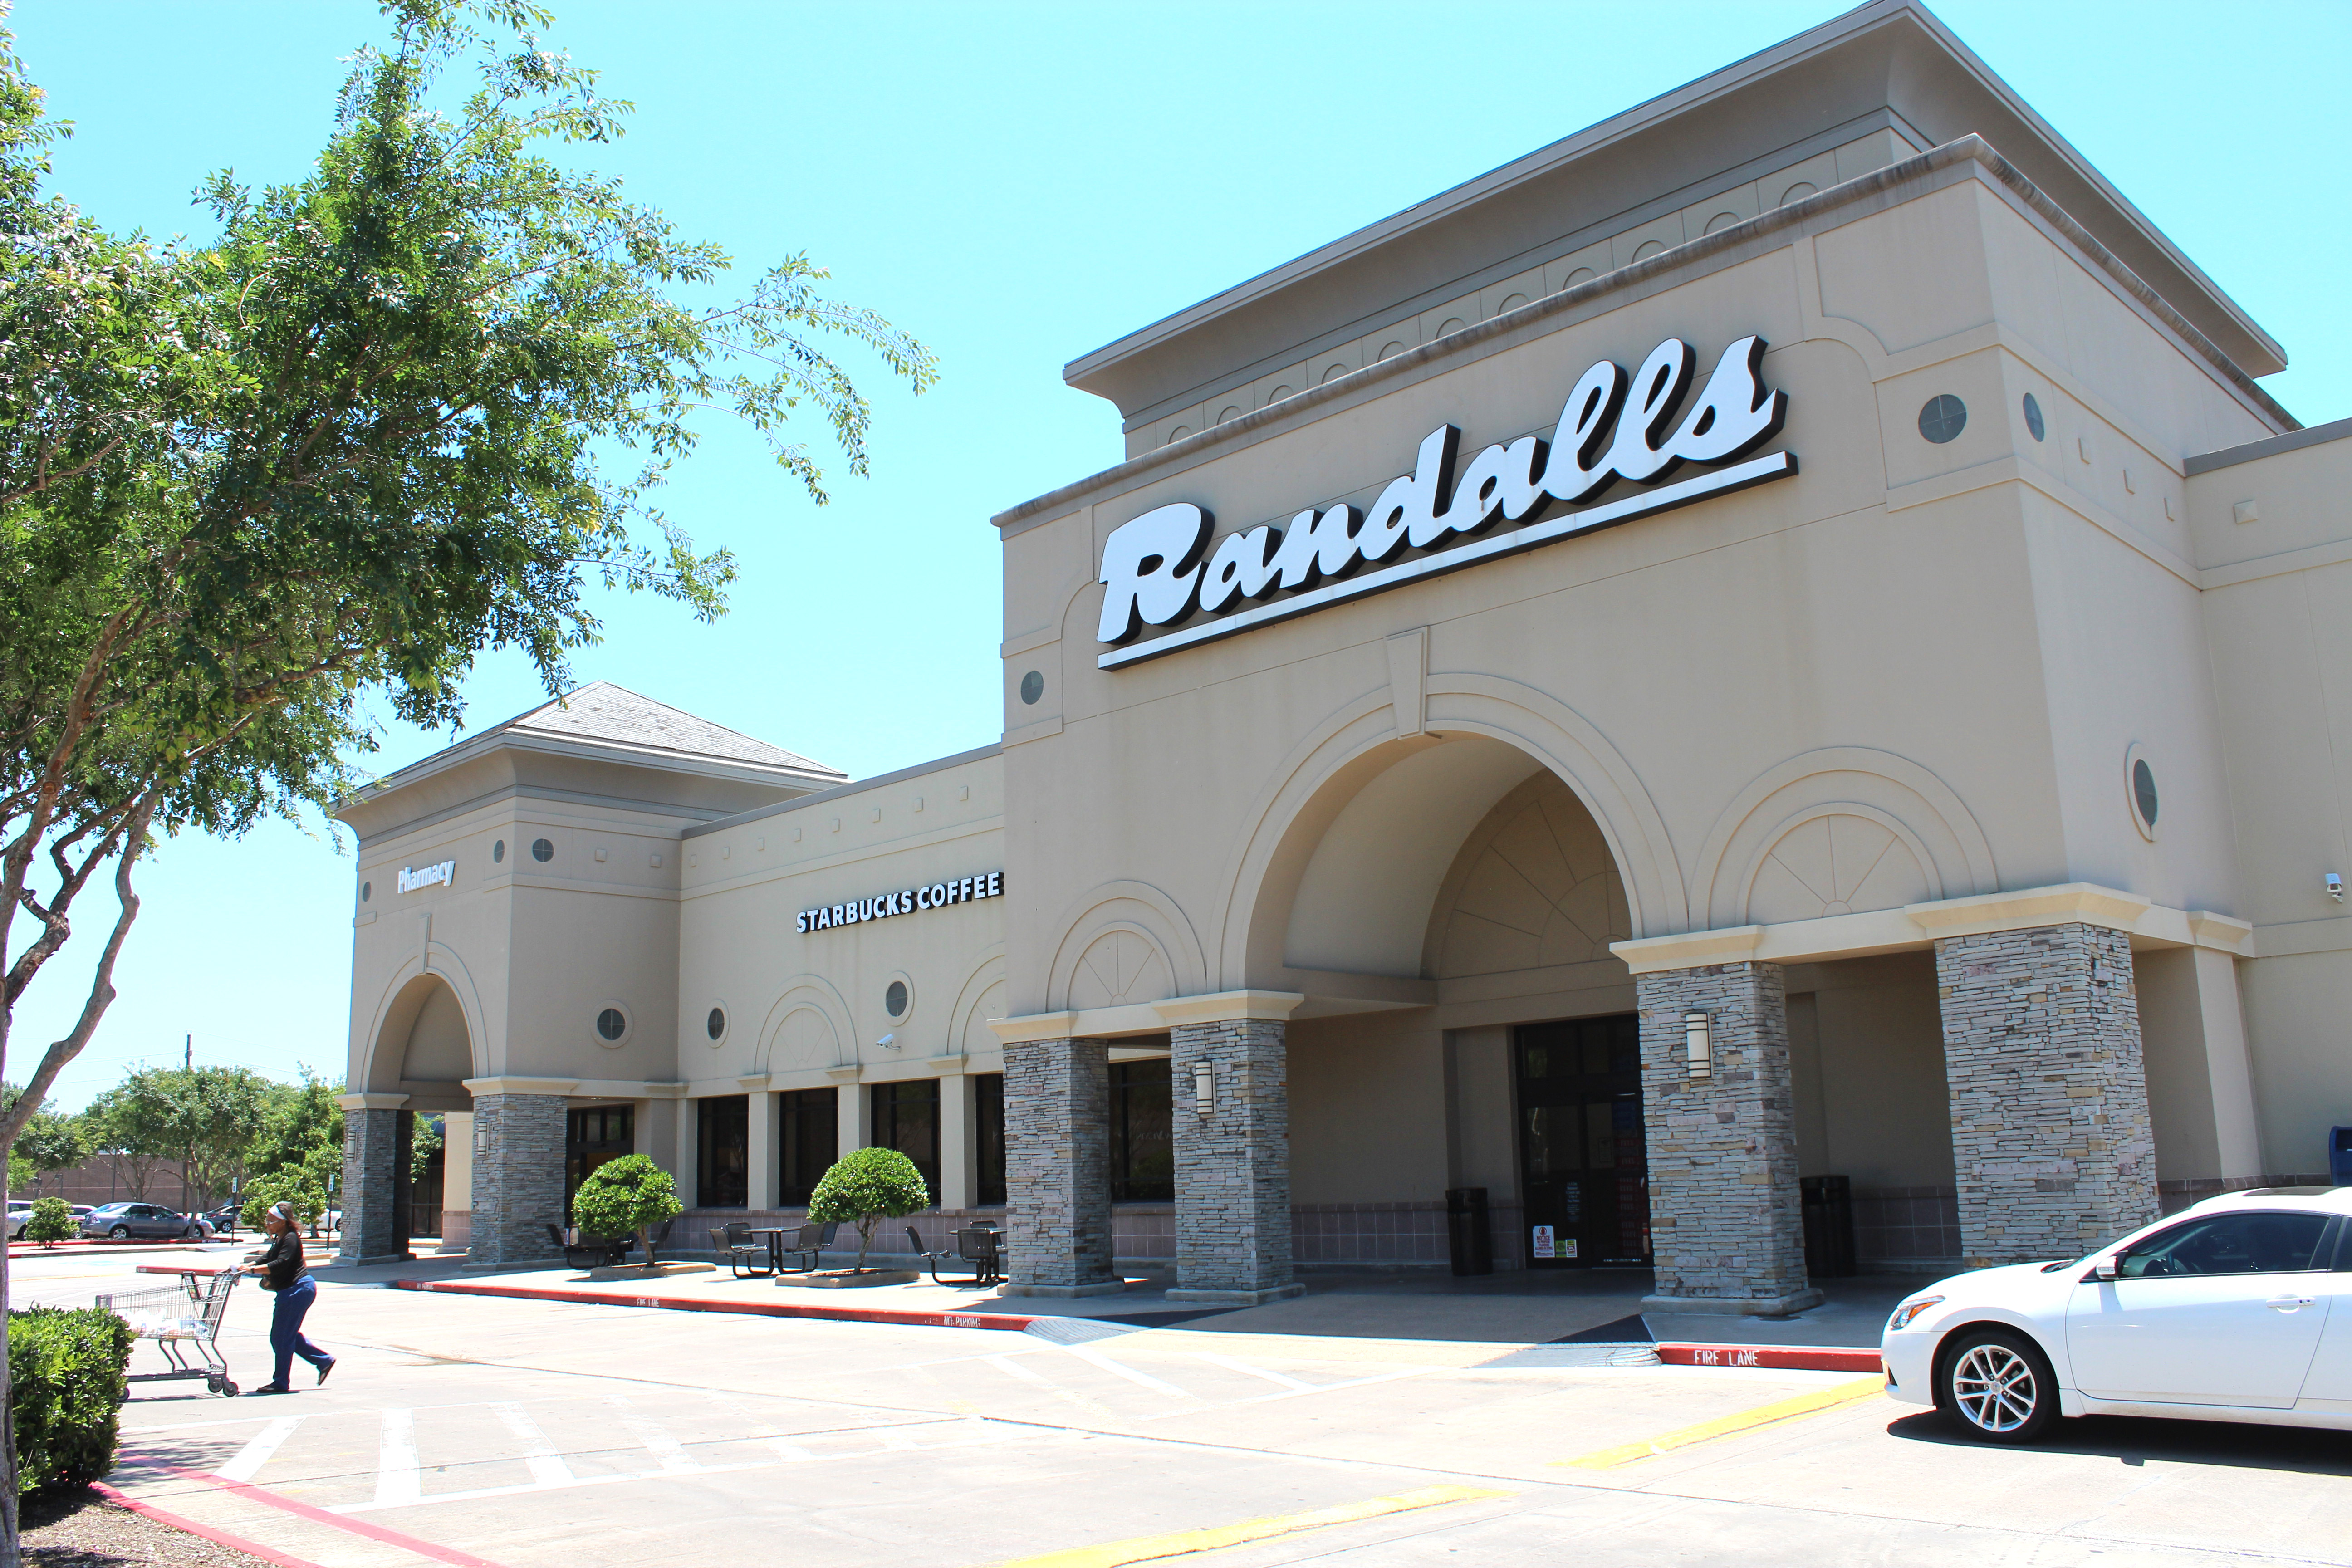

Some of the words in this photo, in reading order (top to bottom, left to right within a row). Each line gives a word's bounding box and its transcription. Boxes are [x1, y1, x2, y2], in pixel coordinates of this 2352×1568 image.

[1097, 335, 1787, 645] Randalls
[398, 860, 455, 893] Pharmacy
[796, 890, 916, 933] STARBUCKS
[917, 872, 1003, 910] COFFEE
[956, 1316, 980, 1328] PARKING
[1694, 1350, 1720, 1365] FIRE
[1728, 1350, 1760, 1366] LANE
